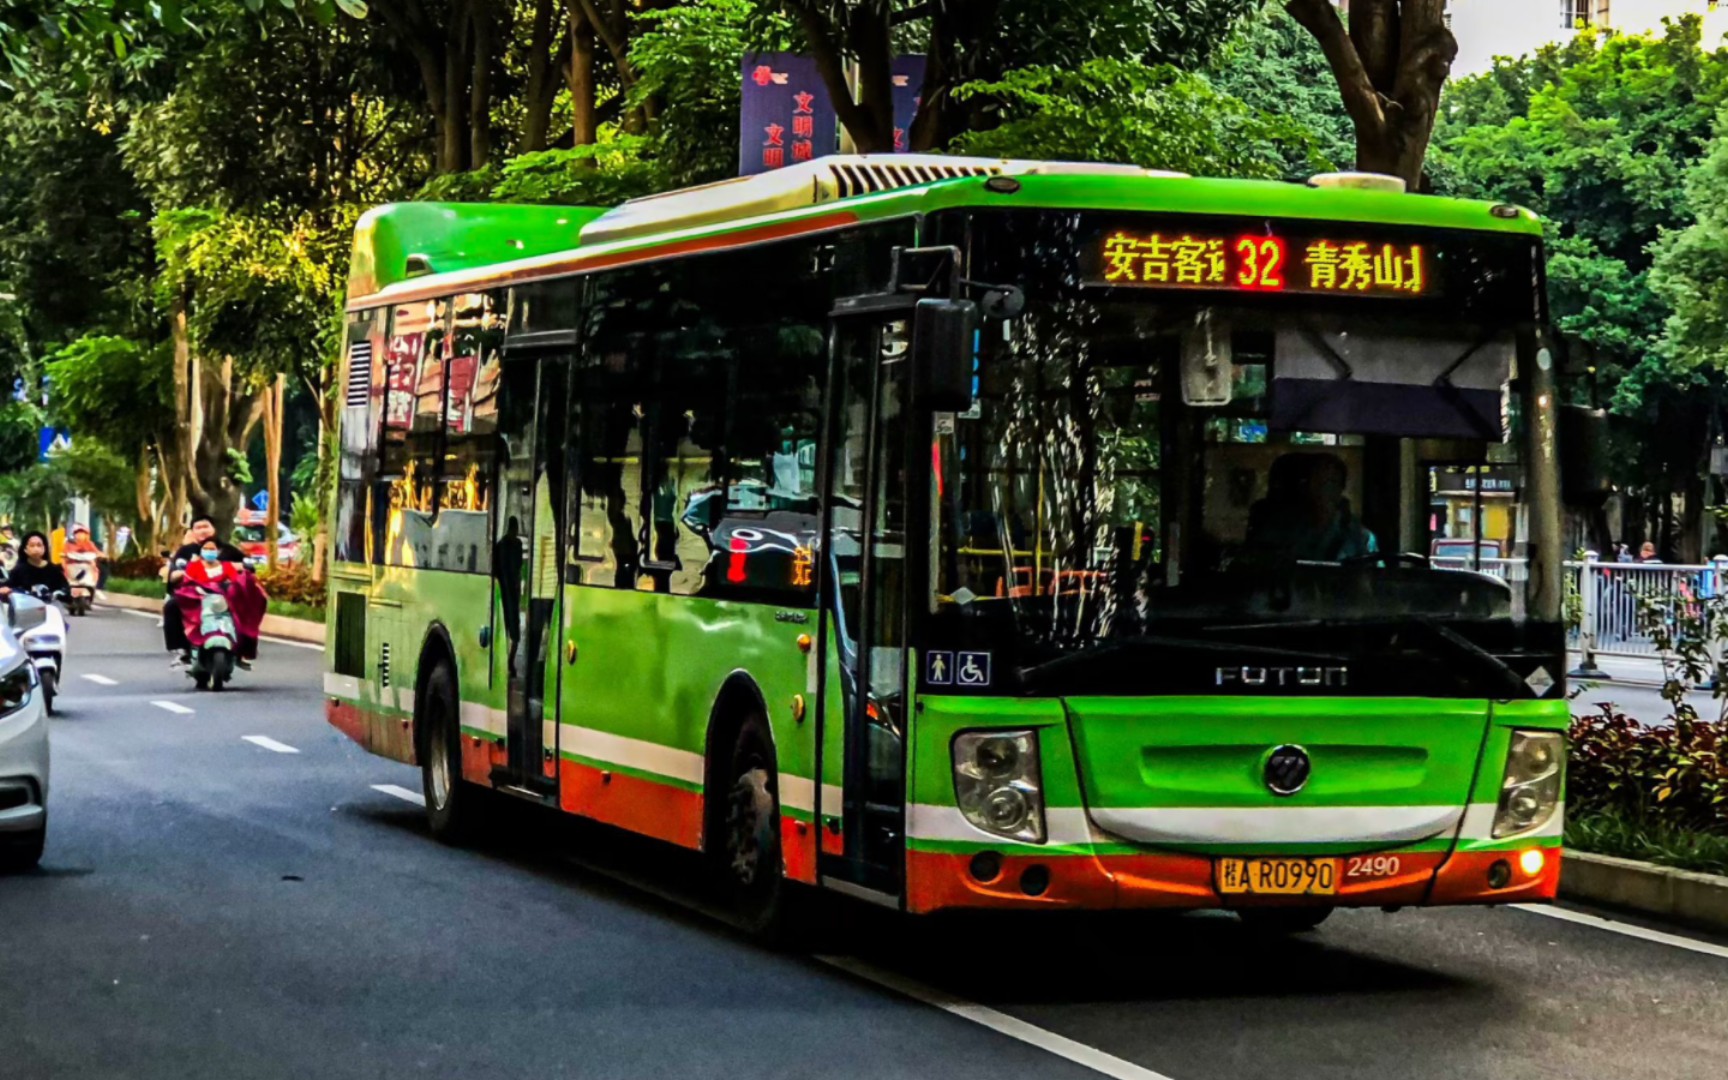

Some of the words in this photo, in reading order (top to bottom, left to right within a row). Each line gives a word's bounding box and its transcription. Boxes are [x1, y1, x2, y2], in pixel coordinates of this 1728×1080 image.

[1236, 239, 1281, 287] 32
[1216, 666, 1347, 686] FOTON
[1347, 856, 1400, 877] 2490
